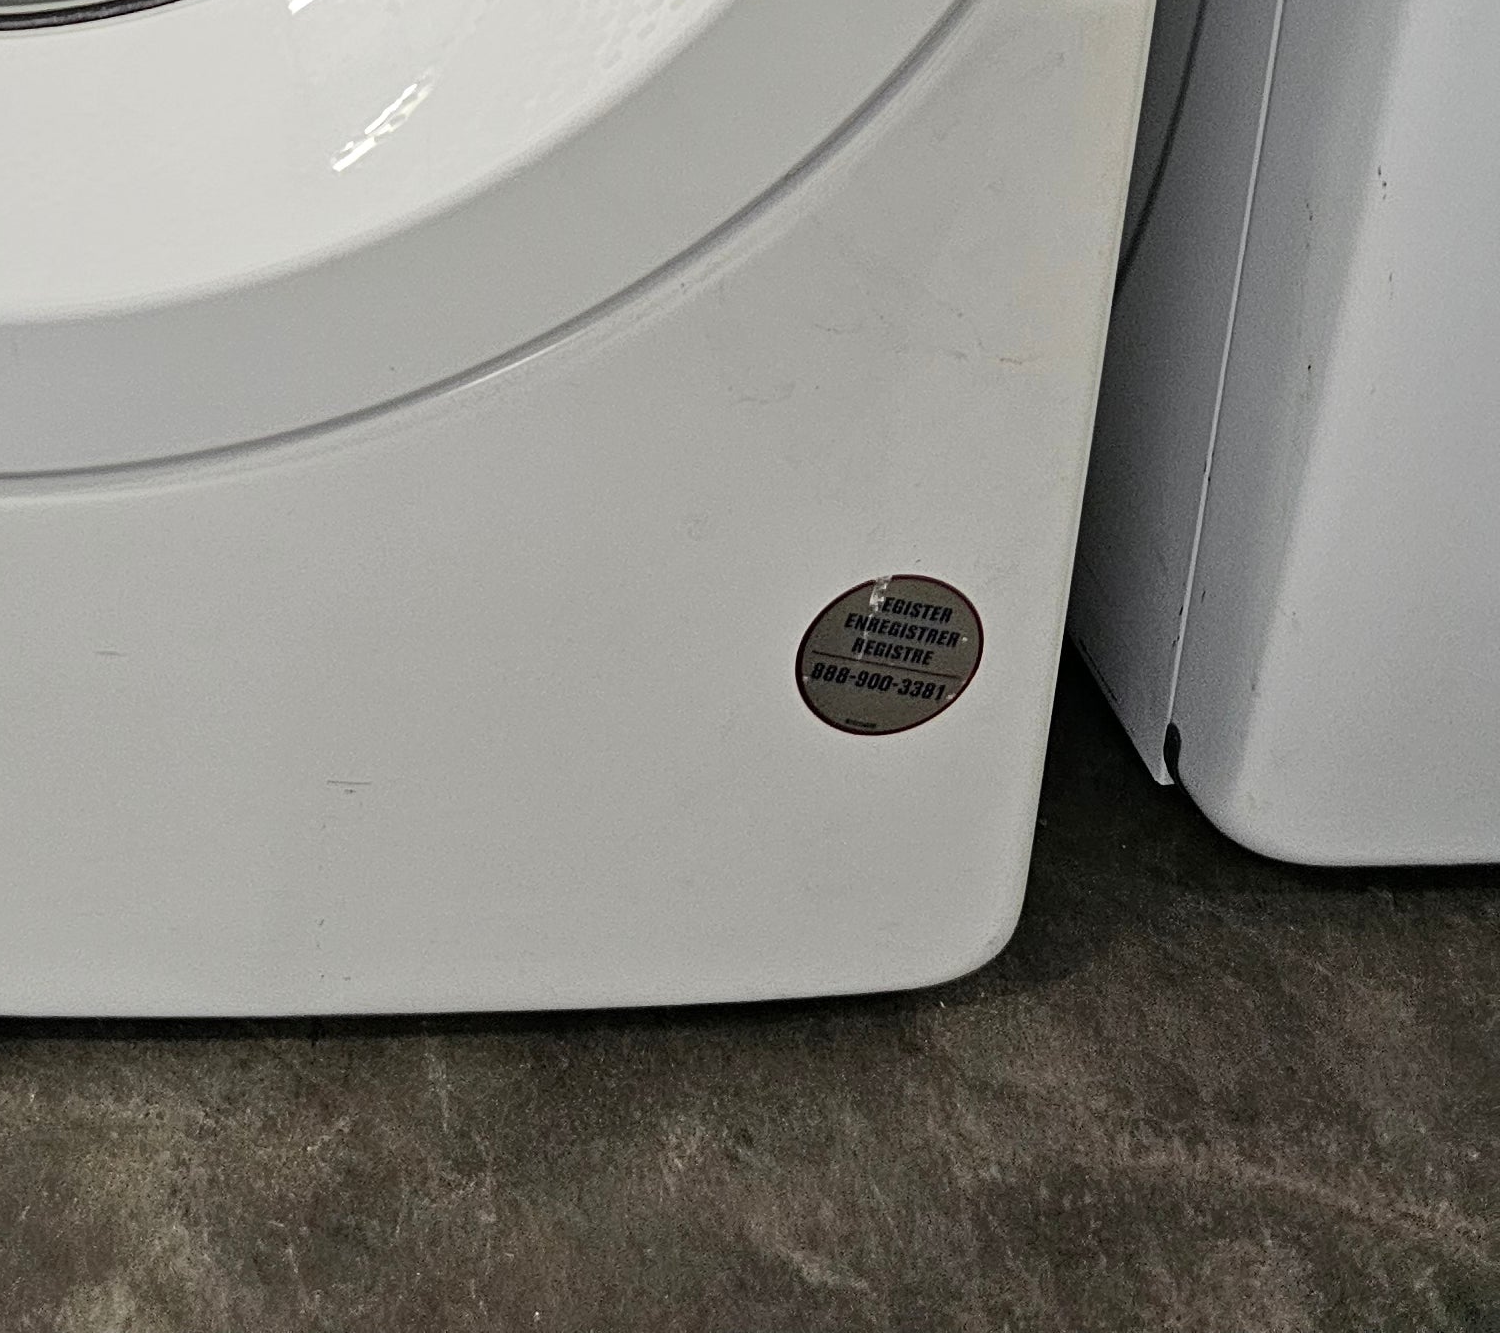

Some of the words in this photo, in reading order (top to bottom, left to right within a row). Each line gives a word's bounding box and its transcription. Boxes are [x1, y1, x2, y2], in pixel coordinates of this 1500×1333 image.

[879, 596, 953, 624] EGISTER
[844, 613, 961, 648] ENREGISTRER
[851, 637, 934, 666] REGISTRE
[811, 662, 946, 701] 888-900-3381
